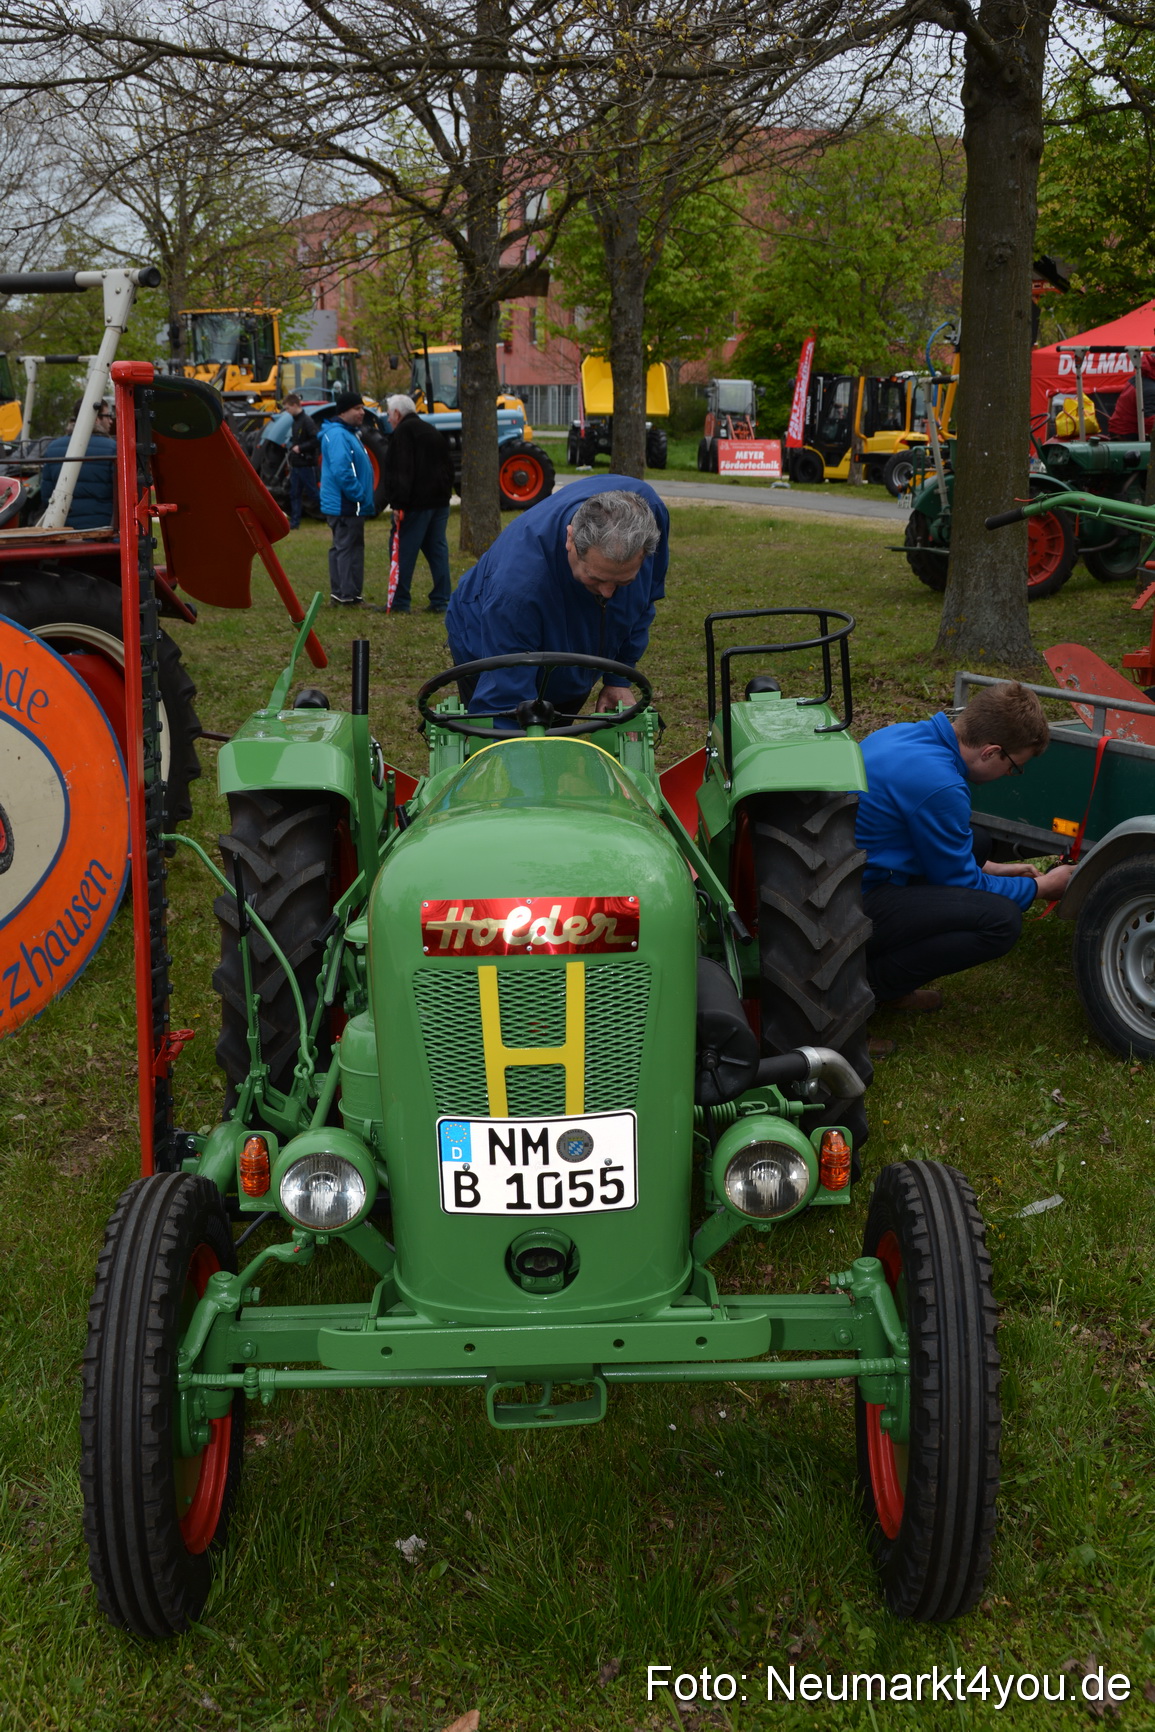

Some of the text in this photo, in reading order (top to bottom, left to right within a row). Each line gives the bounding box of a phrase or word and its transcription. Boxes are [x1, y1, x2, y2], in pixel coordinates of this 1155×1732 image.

[720, 460, 779, 470] Fördertechnik
[735, 450, 765, 460] MEYER
[426, 905, 635, 949] Holder
[477, 961, 585, 1119] H
[451, 1147, 463, 1160] D
[488, 1127, 550, 1166] NM
[454, 1165, 625, 1210] B 1055
